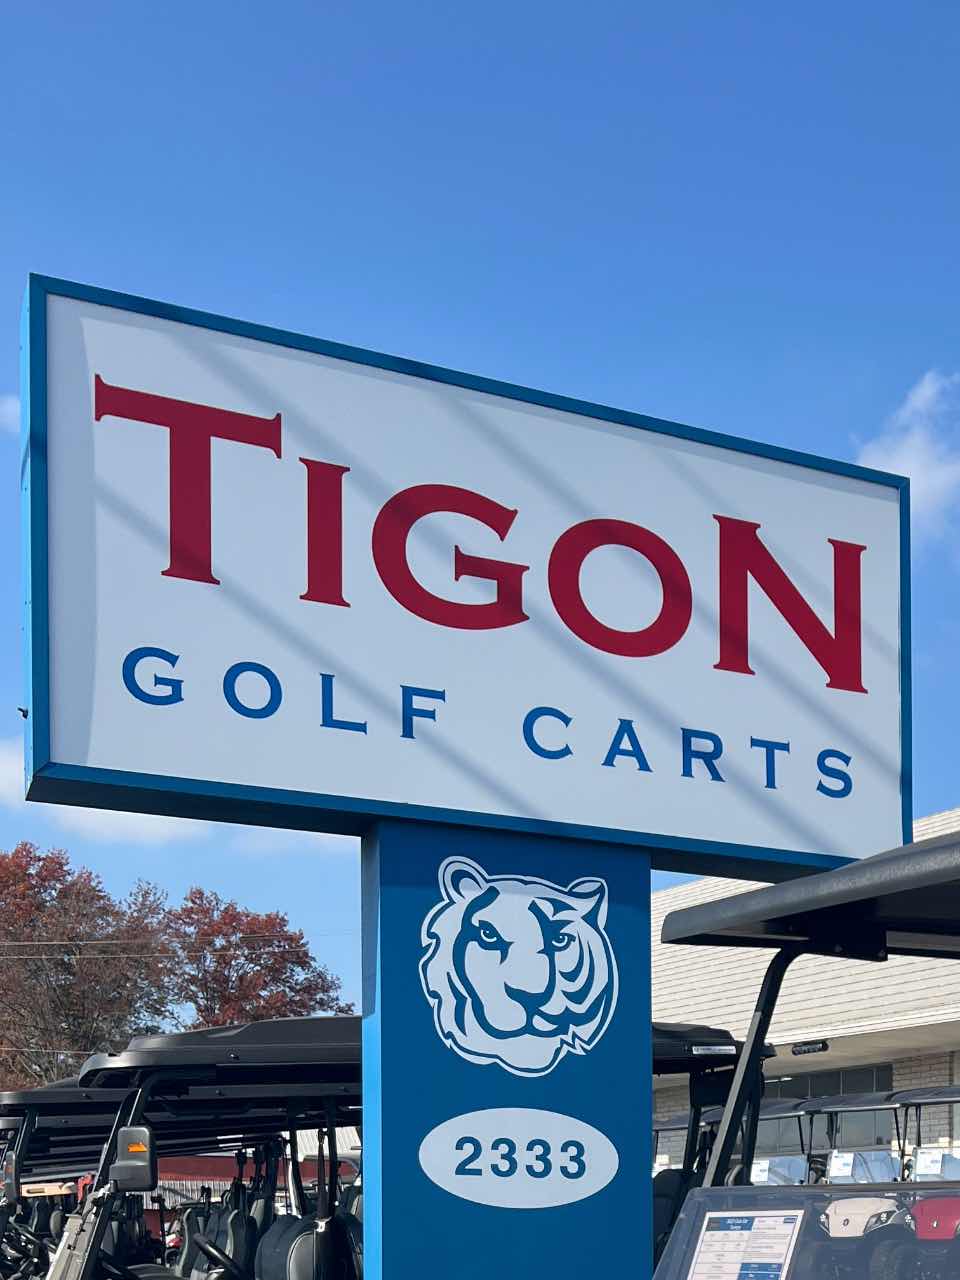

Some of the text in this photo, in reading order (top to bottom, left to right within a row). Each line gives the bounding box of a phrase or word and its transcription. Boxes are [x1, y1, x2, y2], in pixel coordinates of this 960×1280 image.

[94, 374, 868, 694] TIGON
[122, 646, 854, 799] GOLF CARTS
[454, 1135, 587, 1180] 2333
